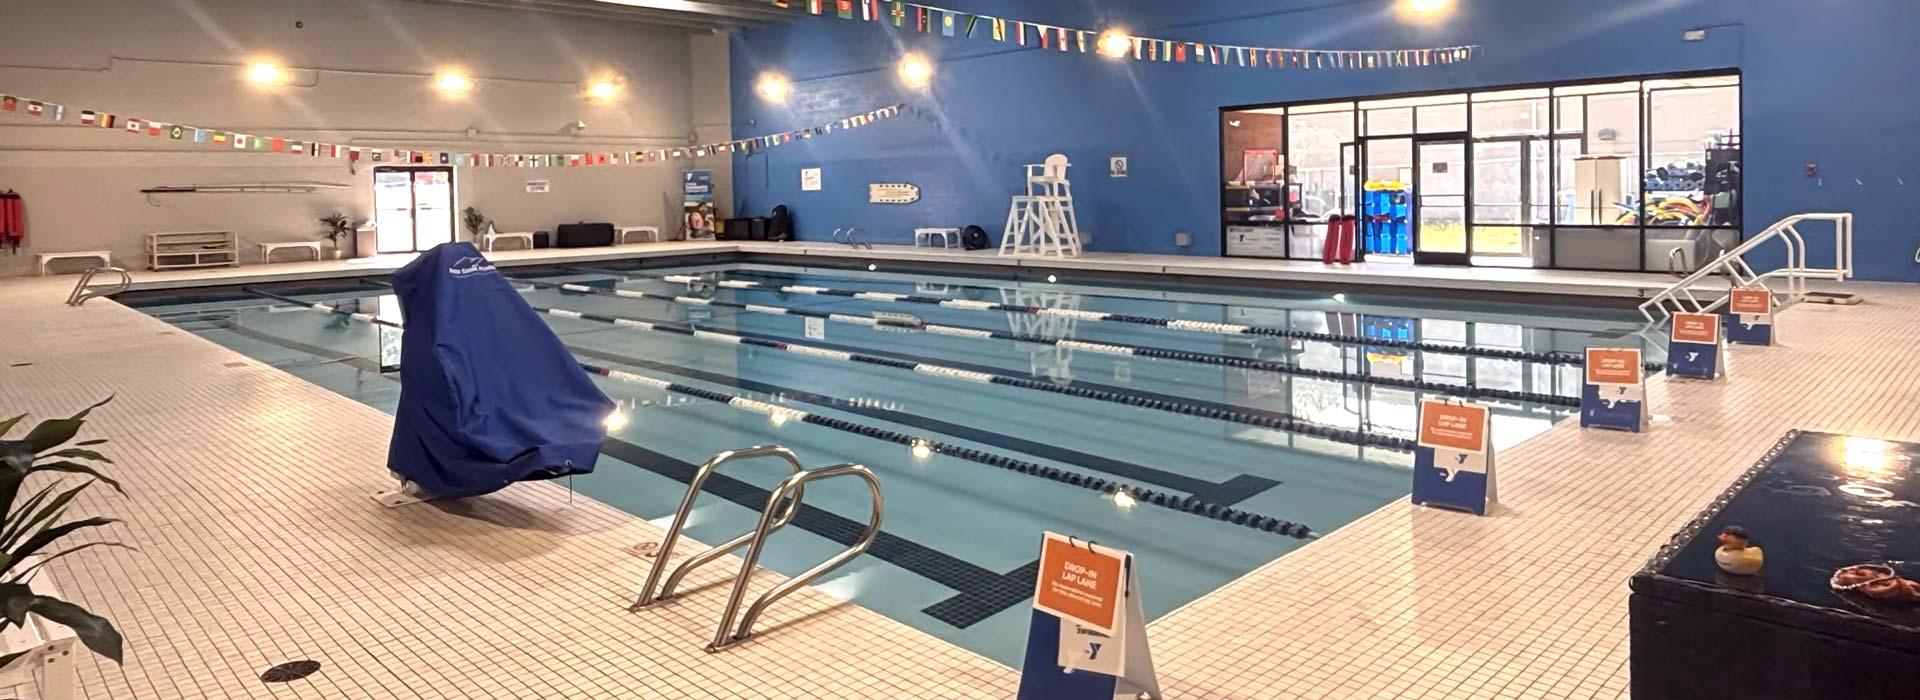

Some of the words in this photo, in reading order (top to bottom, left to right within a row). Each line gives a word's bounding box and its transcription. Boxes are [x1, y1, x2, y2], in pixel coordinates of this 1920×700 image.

[1064, 561, 1098, 579] DROP-IN
[1062, 571, 1077, 582] LAP
[1076, 576, 1097, 590] LANE
